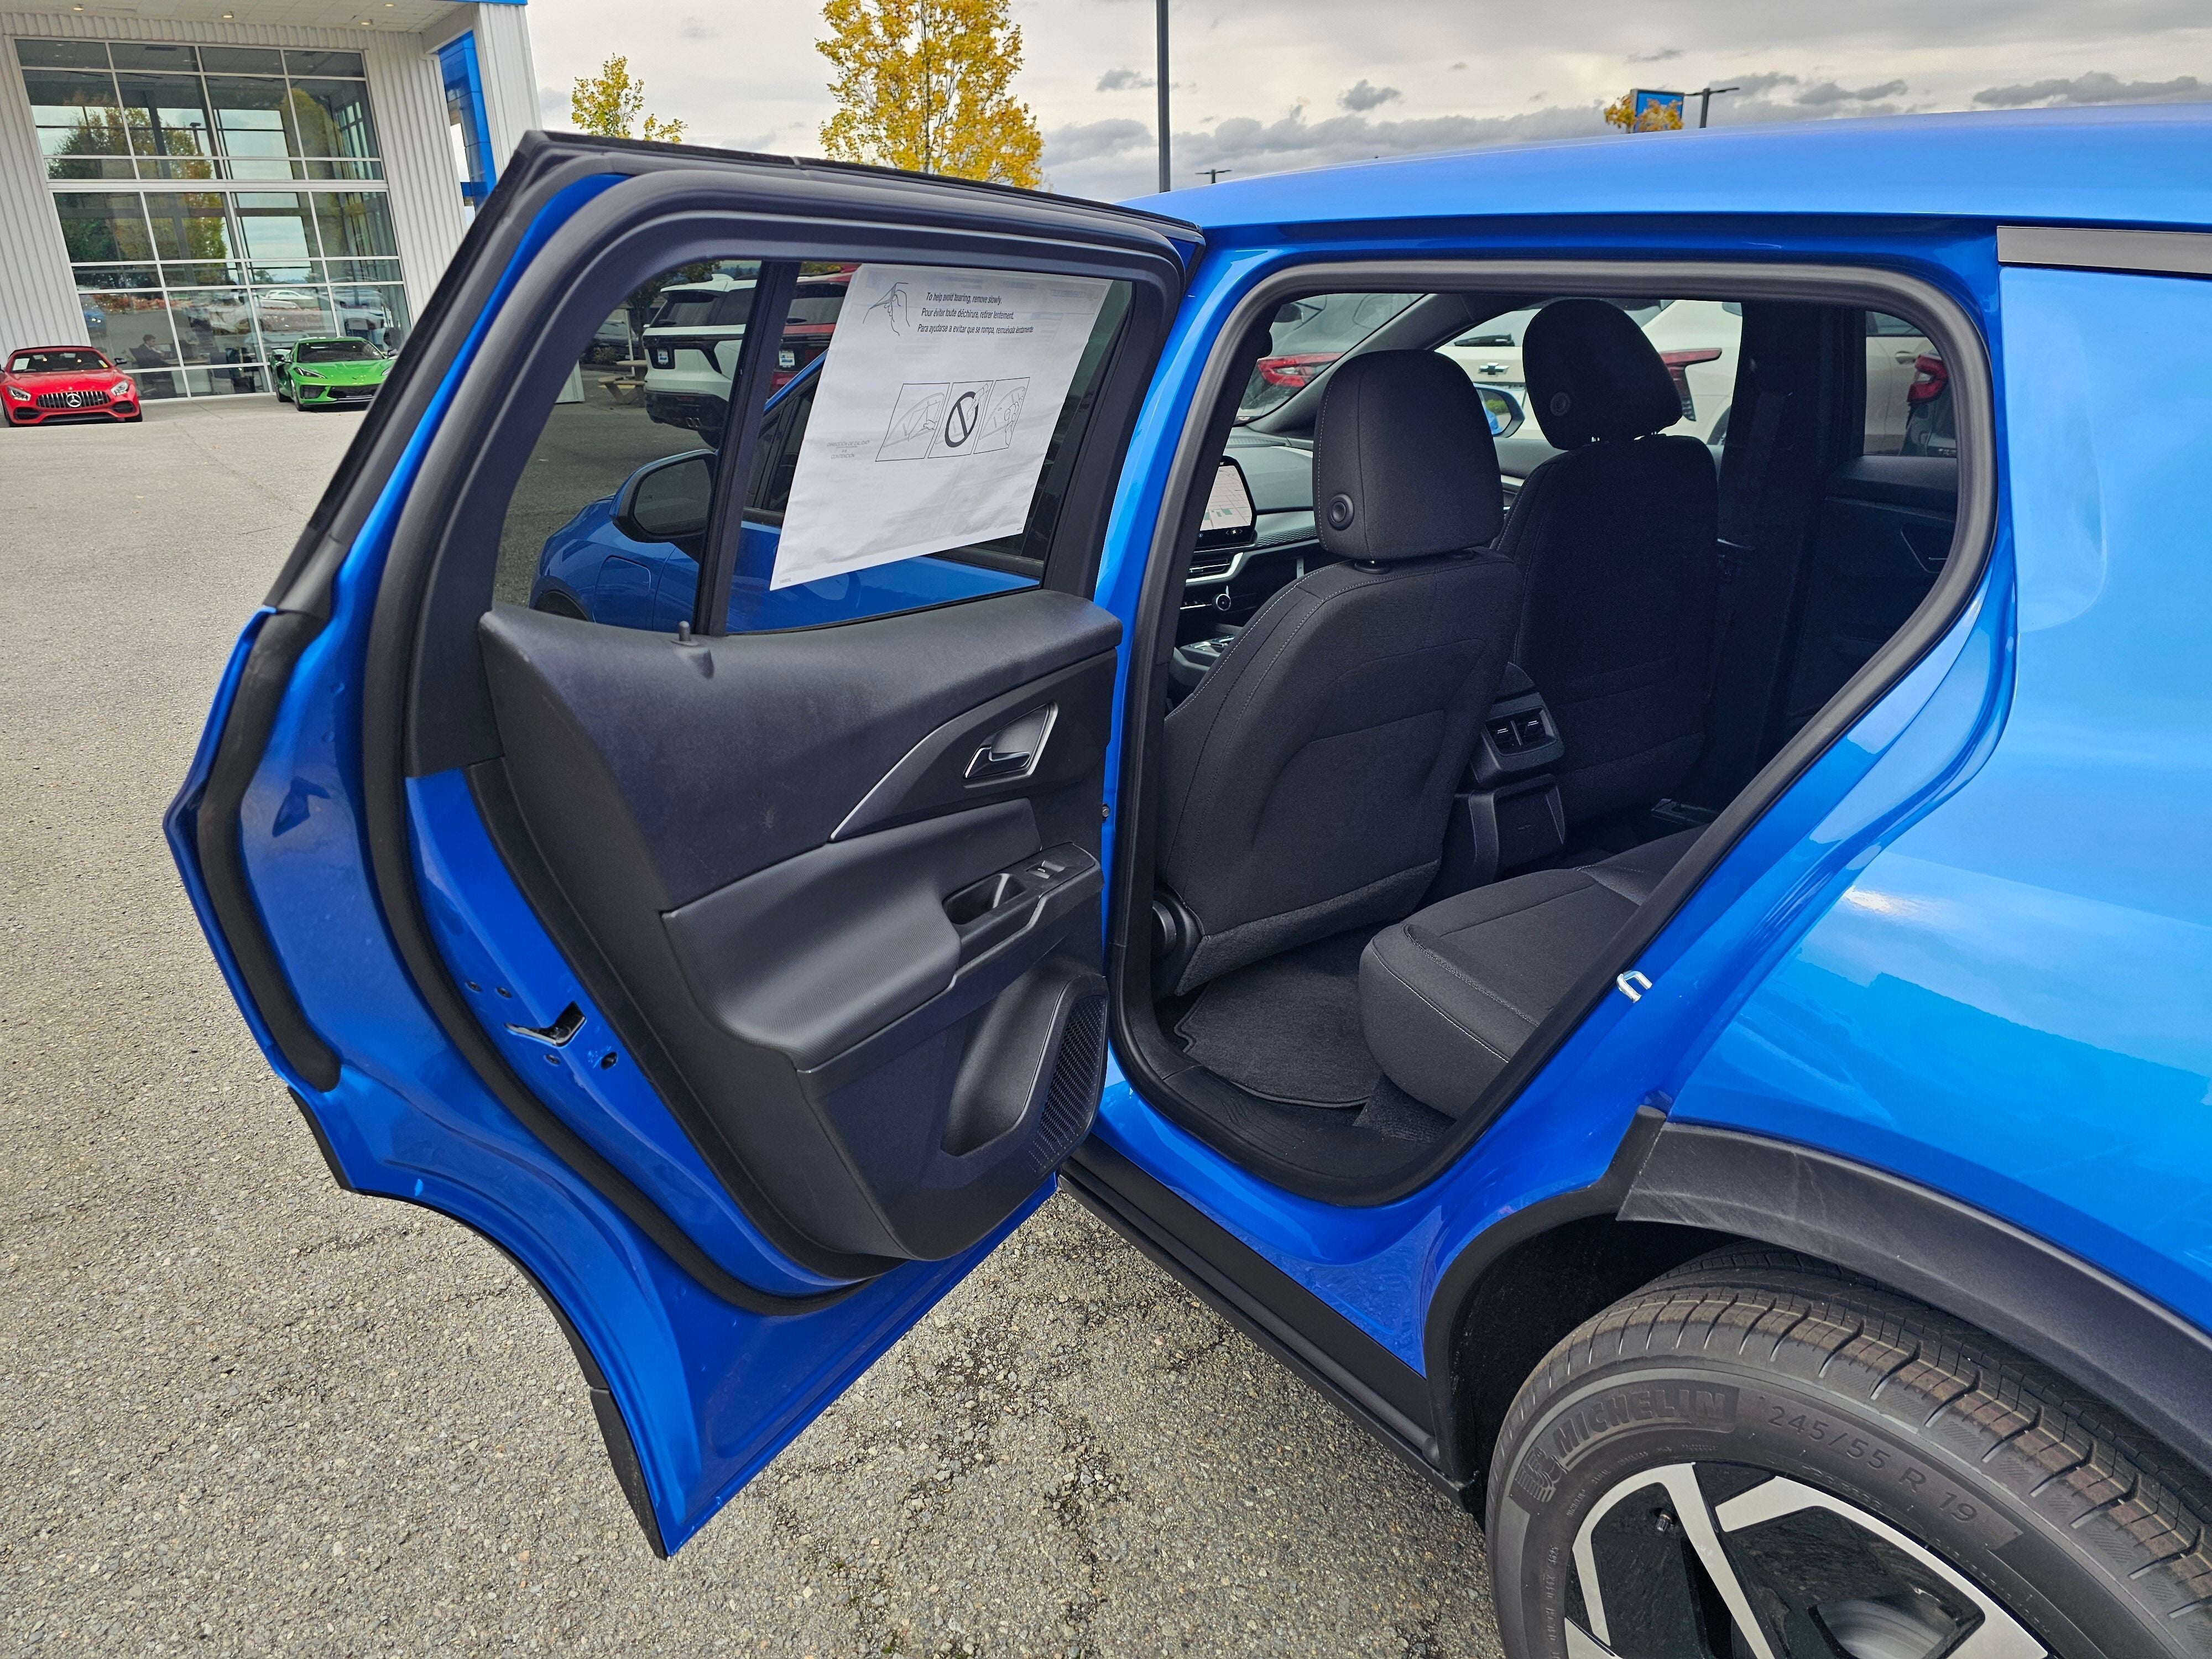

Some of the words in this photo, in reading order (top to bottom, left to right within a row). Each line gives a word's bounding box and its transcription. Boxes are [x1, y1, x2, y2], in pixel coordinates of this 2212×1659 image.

[926, 291, 933, 301] To
[933, 293, 942, 303] help
[942, 293, 954, 301] avoid
[954, 293, 971, 304] tearing,
[988, 295, 1002, 306] slowly.
[921, 307, 933, 317] Pour
[933, 308, 945, 317] éviter
[945, 309, 957, 317] toute
[957, 309, 979, 319] déchirure,
[980, 310, 993, 319] retirer
[917, 324, 929, 332] Para
[929, 324, 948, 334] ayudarse
[953, 325, 967, 333] evitar
[980, 327, 995, 335] rompa,
[1552, 1389, 1725, 1459] MICHELIN
[1768, 1405, 1891, 1469] 245/55
[1899, 1467, 1927, 1493] R
[1939, 1491, 1978, 1522] 19
